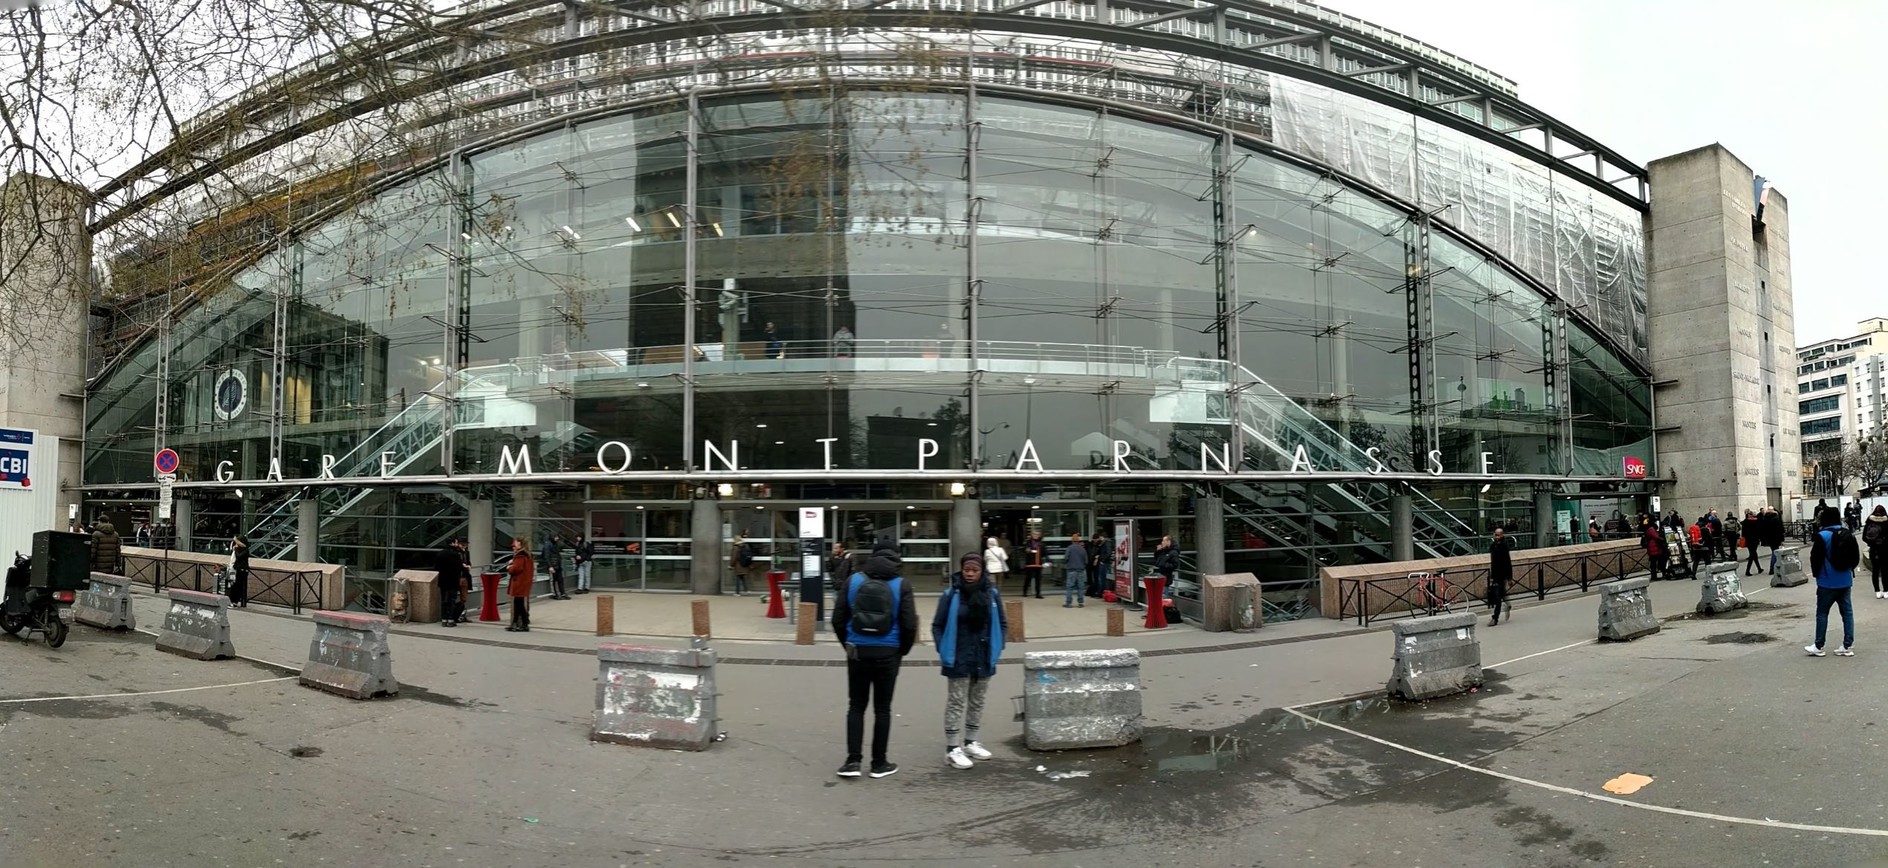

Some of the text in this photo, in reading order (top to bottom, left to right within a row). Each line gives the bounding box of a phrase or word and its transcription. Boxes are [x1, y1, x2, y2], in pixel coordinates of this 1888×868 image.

[0, 456, 27, 474] CBI
[216, 451, 397, 484] GARE
[497, 437, 1495, 478] MONTPARNASSE
[1626, 464, 1646, 475] SNCF
